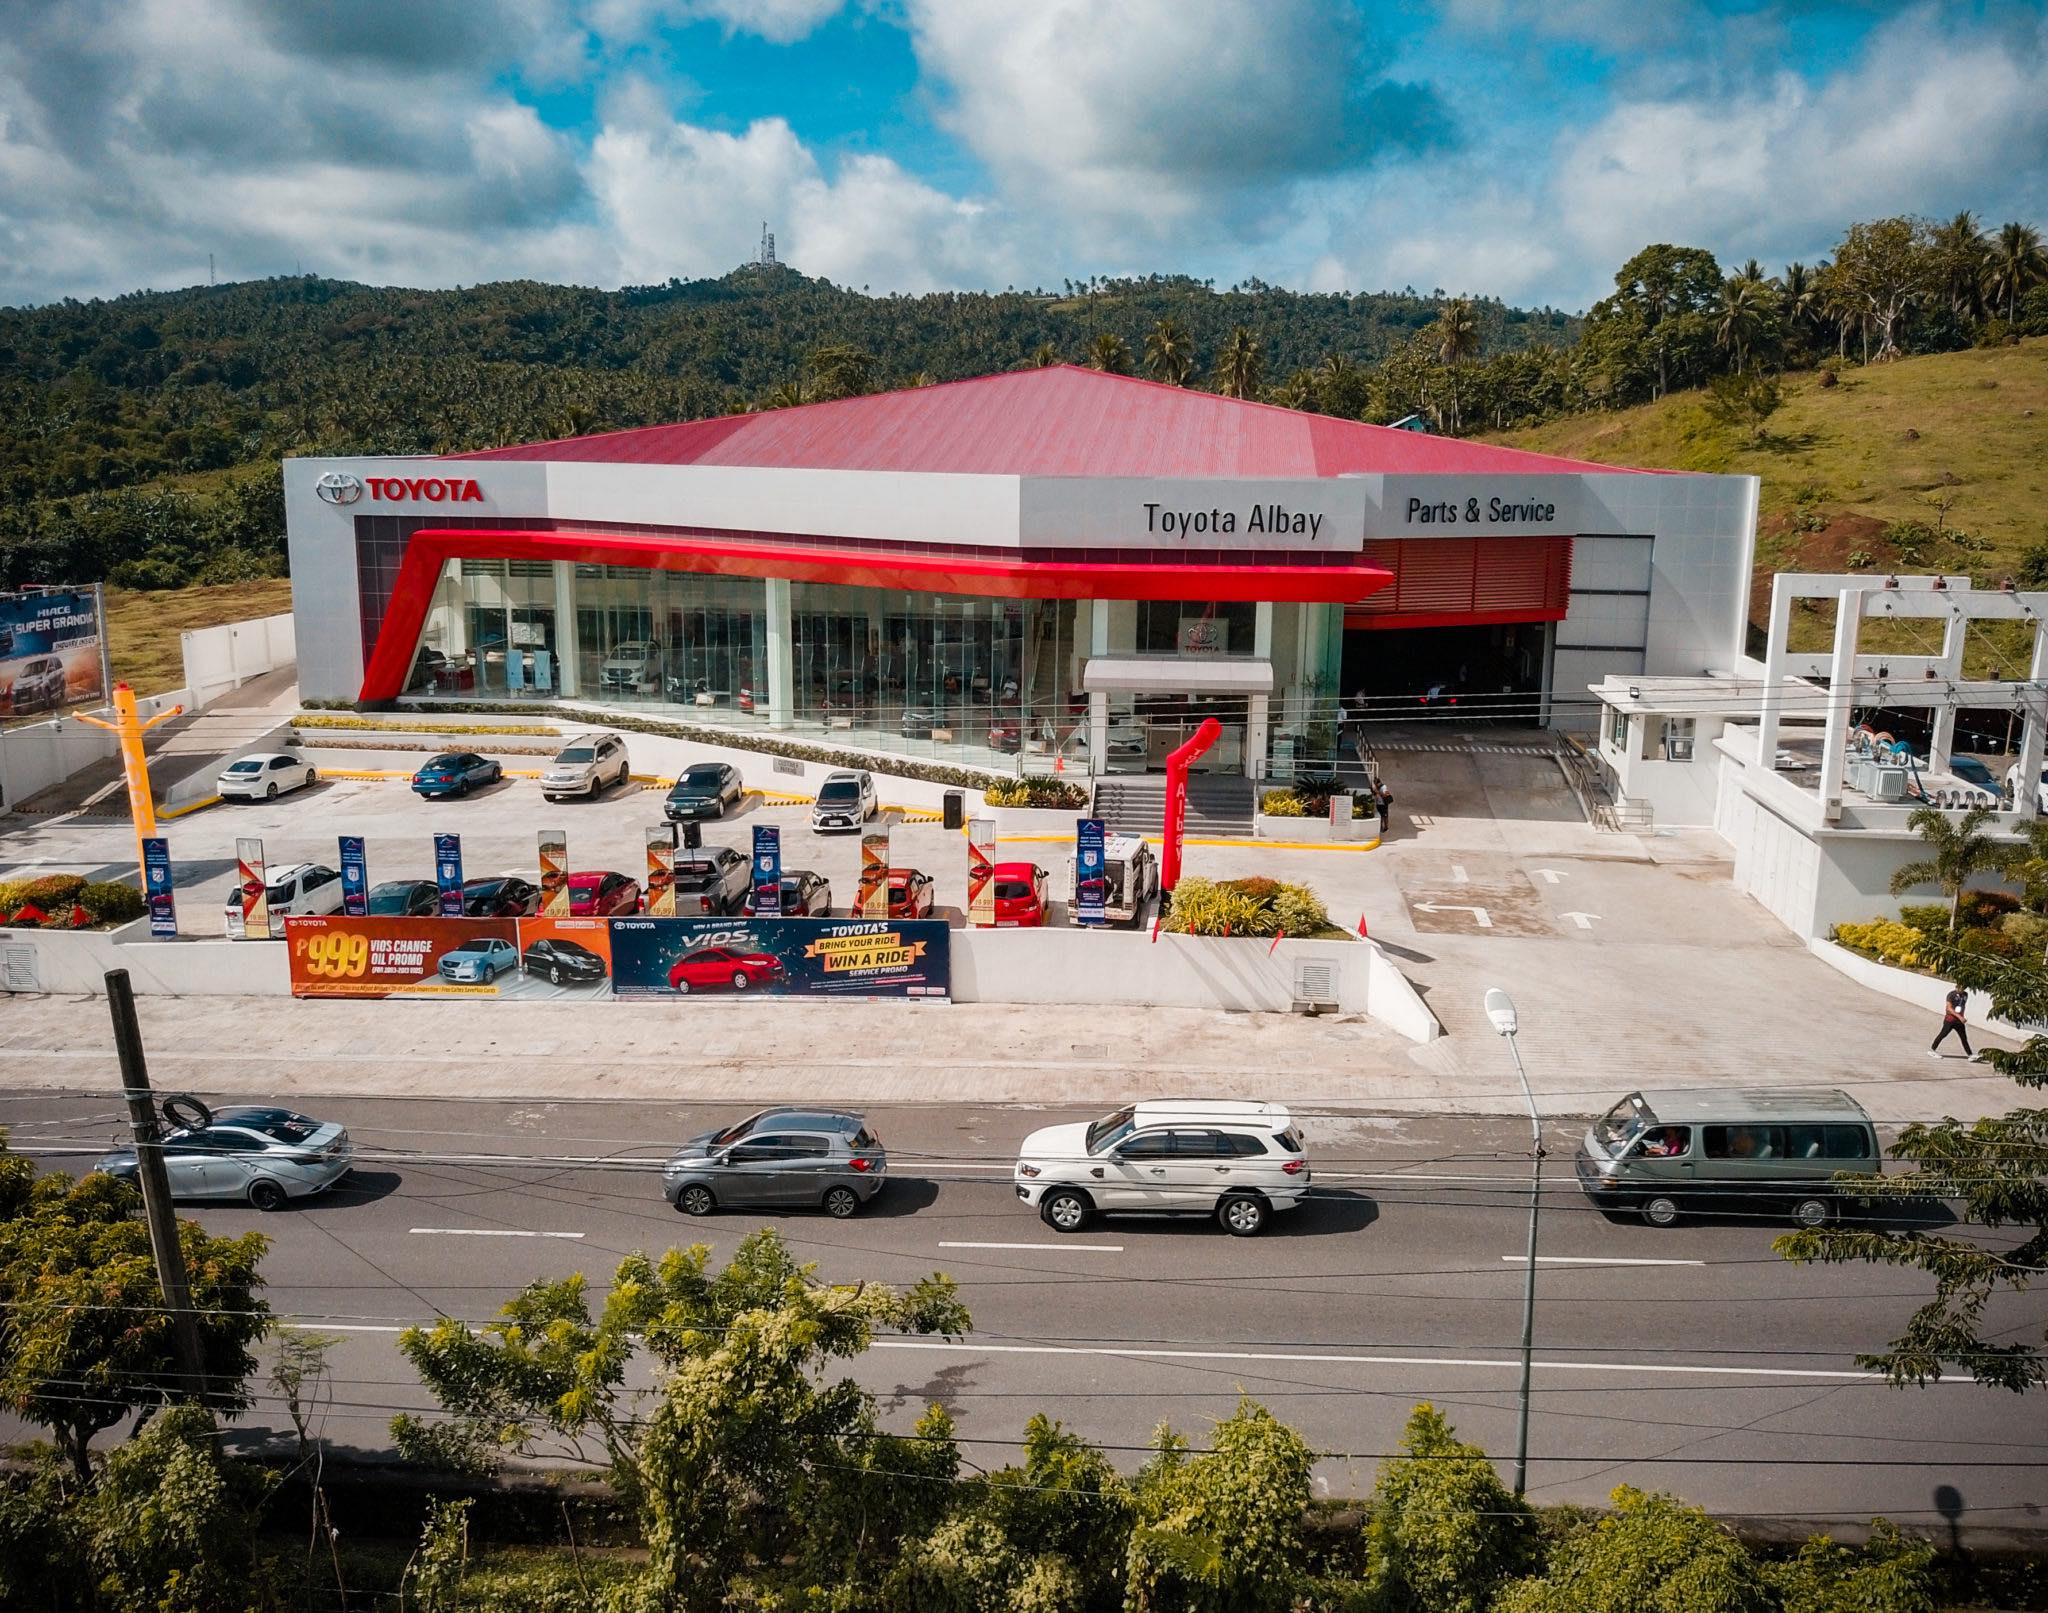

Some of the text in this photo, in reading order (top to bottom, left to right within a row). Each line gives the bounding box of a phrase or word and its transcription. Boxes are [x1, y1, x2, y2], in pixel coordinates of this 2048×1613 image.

[365, 478, 484, 502] TOYOTA
[1407, 497, 1555, 523] Parts & Service
[1143, 503, 1323, 540] Toyota Albay
[37, 605, 71, 618] HIACE
[15, 612, 95, 635] SUPER GRANDIA
[1184, 645, 1220, 653] TOYOTA
[1175, 782, 1185, 862] Albay
[626, 922, 656, 930] TOYOTA
[711, 921, 732, 929] BRAND
[831, 922, 889, 937] TOYOTA'S
[370, 939, 433, 953] VIOS CHANGE
[681, 929, 750, 948] VIOS
[819, 936, 896, 951] BRING YOUR RIDE
[371, 952, 424, 966] OIL PROMO
[829, 949, 910, 969] WIN A RIDE
[849, 965, 908, 977] SERVICE PROMO
